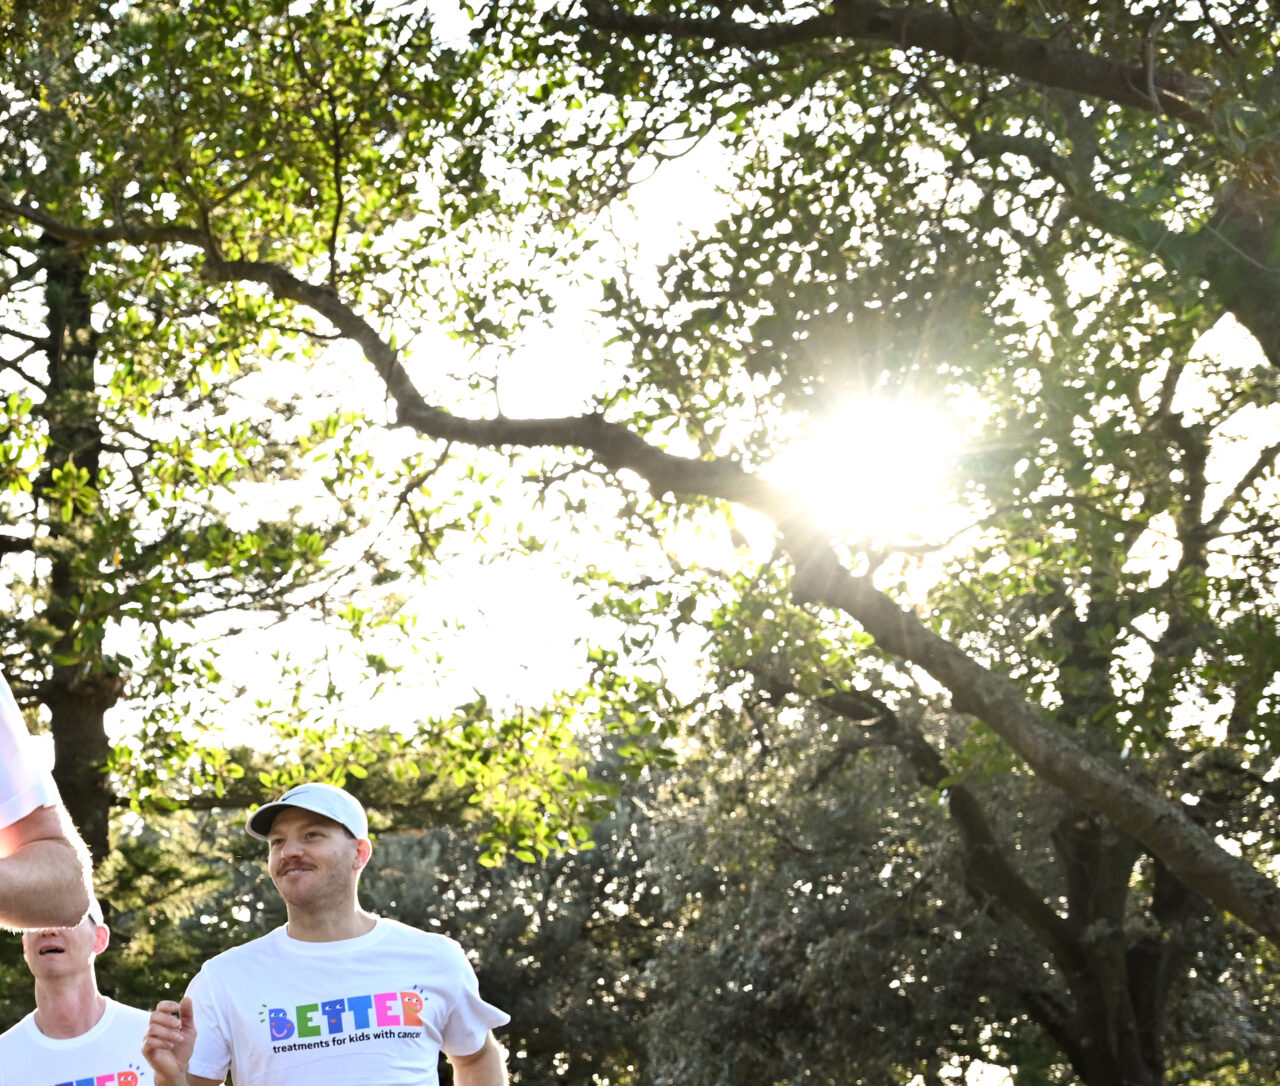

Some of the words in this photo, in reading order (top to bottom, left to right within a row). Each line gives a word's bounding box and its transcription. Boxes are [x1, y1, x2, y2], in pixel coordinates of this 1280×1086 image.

[268, 991, 424, 1042] BETTER
[272, 1039, 330, 1054] treatments
[332, 1036, 346, 1046] for
[349, 1031, 370, 1043] kids
[372, 1029, 396, 1040] with
